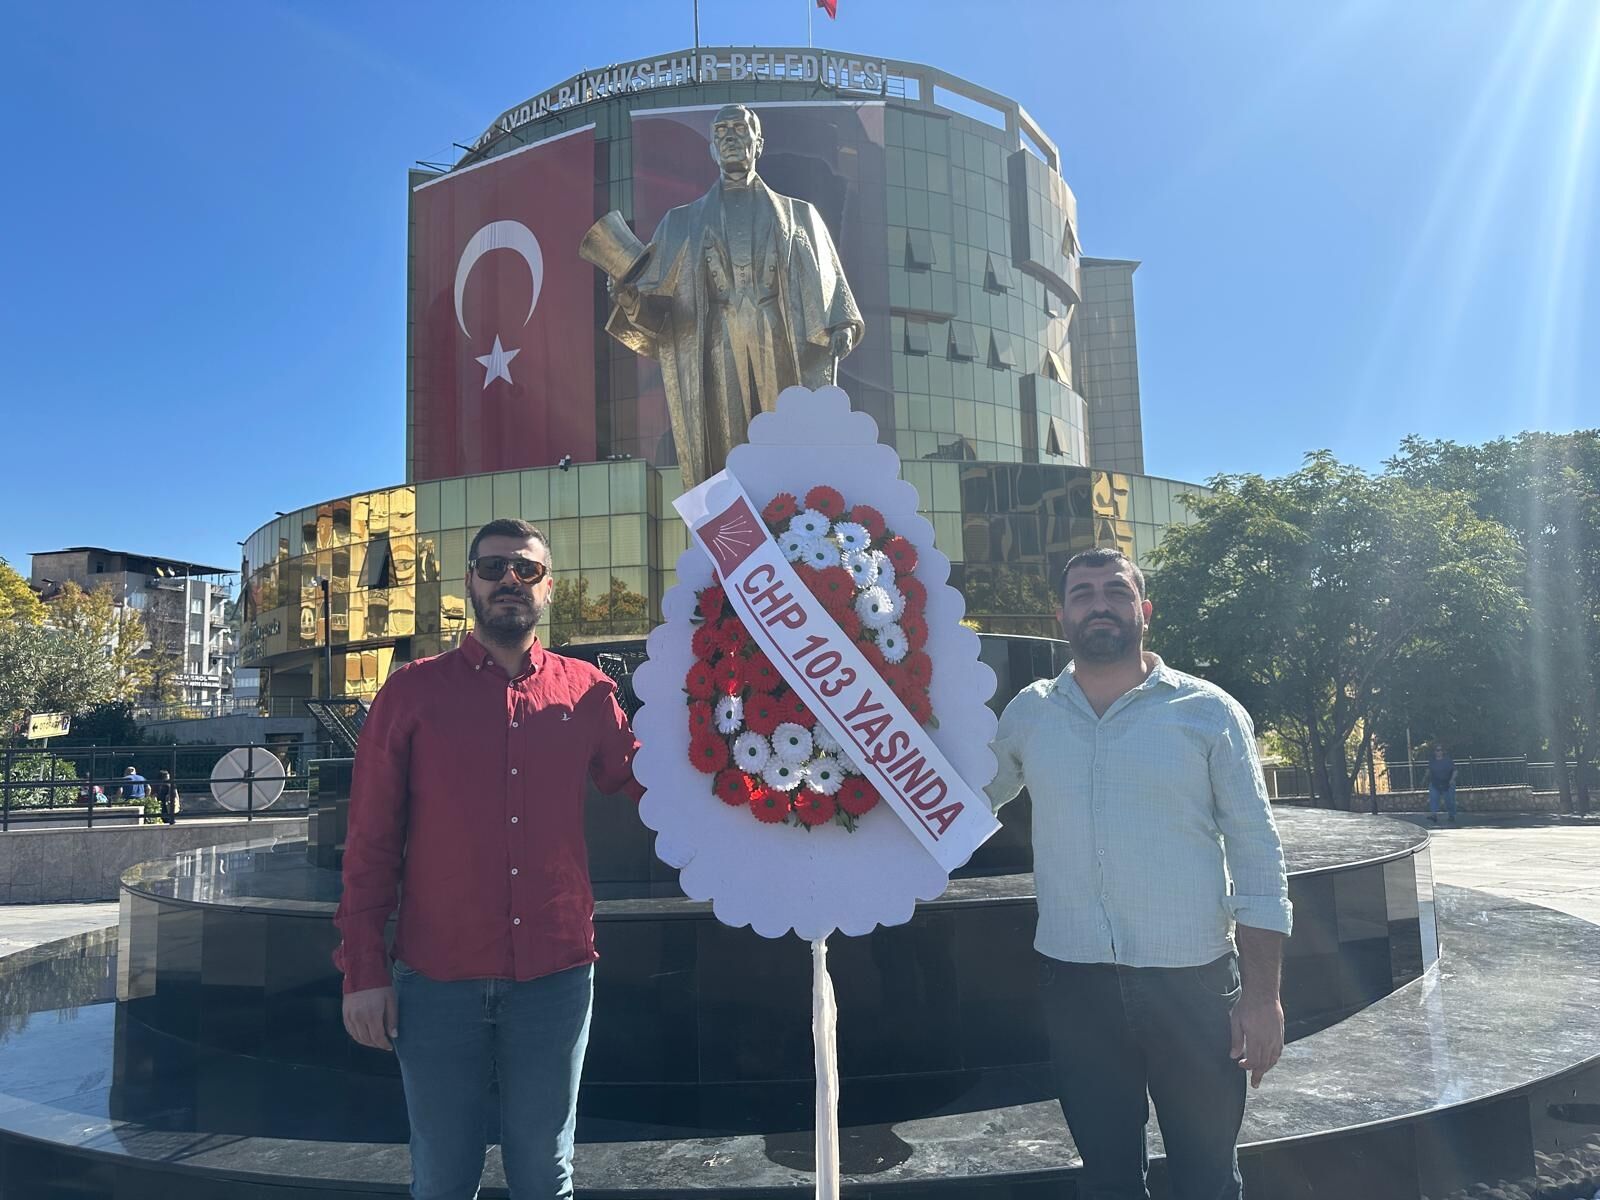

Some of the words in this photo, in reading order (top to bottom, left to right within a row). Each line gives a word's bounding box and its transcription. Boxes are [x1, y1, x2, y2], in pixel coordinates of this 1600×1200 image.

[500, 94, 551, 133] AYDIN
[730, 50, 888, 92] BELEDİYESİ
[742, 563, 808, 631] CHP
[791, 634, 857, 698] 103
[843, 688, 966, 835] YAŞINDA
